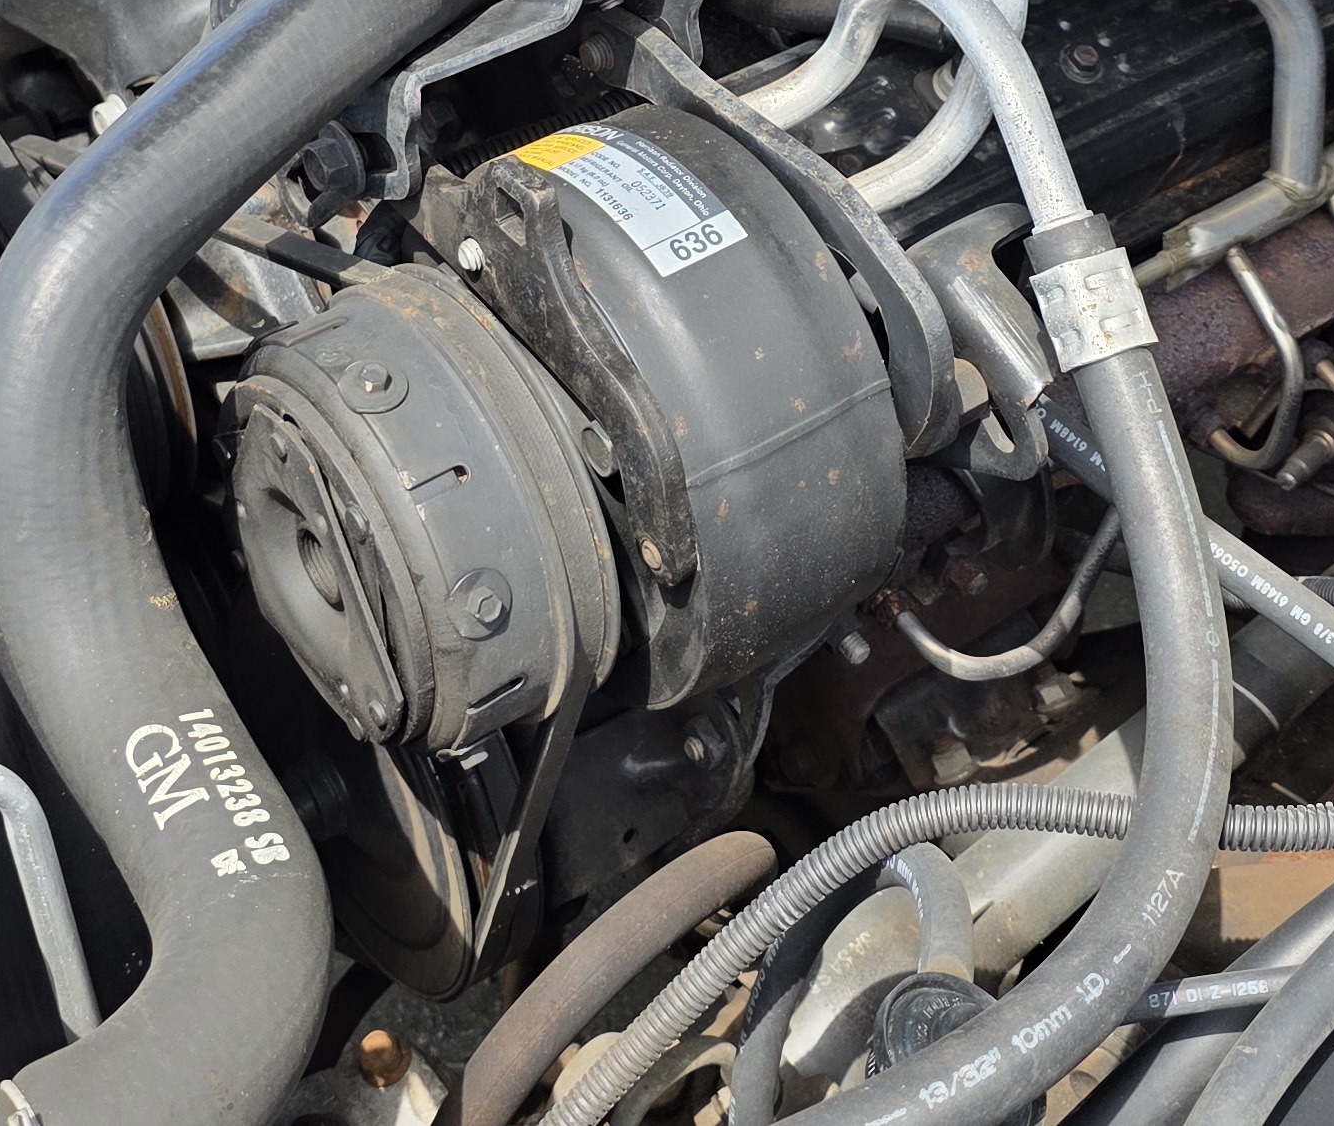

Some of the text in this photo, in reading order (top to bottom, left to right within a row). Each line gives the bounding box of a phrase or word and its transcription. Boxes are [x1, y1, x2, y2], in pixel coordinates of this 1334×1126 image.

[594, 187, 634, 222] 1131636
[630, 179, 667, 211] 052371
[682, 174, 707, 199] Division
[693, 198, 711, 217] Ohio
[668, 223, 725, 262] 636
[1247, 573, 1290, 609] 6148M
[1288, 603, 1313, 627] GM
[125, 724, 210, 831] GM
[178, 708, 290, 865] 14013238 SB
[1141, 867, 1185, 929] 1127A
[1011, 1006, 1073, 1054] 10mm
